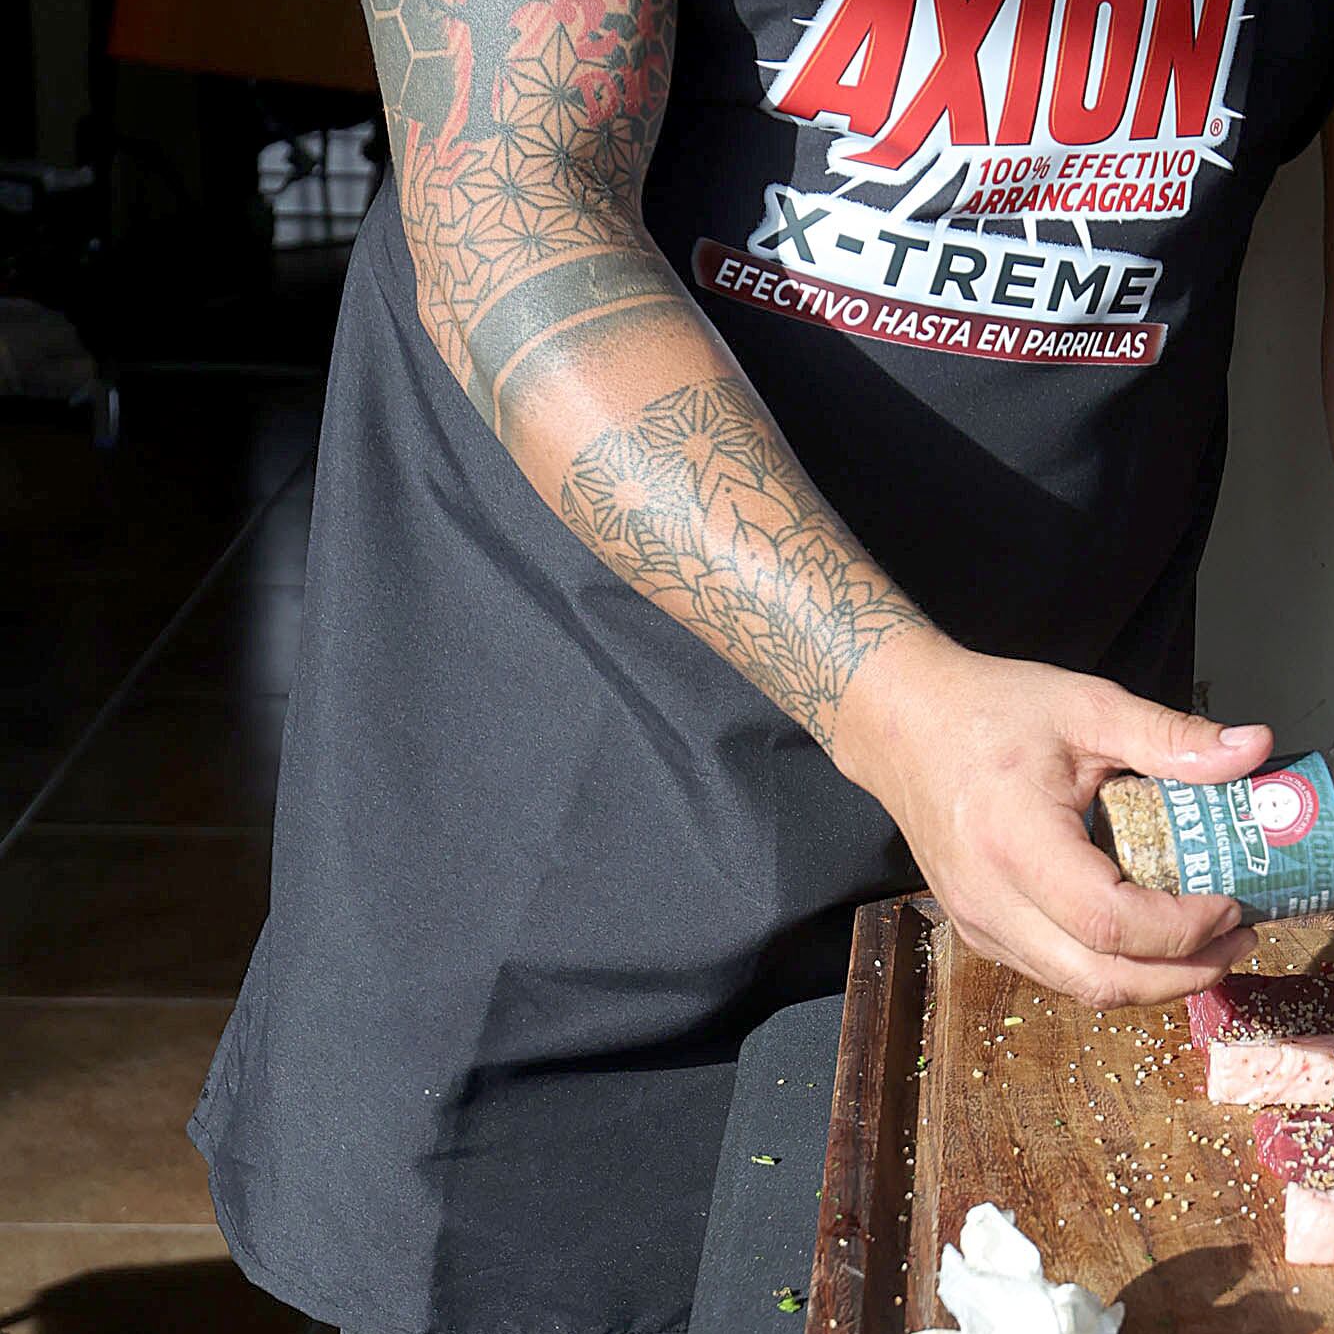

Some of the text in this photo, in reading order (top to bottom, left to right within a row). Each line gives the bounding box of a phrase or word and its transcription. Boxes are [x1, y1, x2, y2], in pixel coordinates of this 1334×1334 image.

[979, 148, 1197, 186] 100% EFECTIVO
[960, 181, 1187, 214] ARRANCAGRASA
[757, 191, 1158, 316] X-TREME
[714, 258, 1150, 360] EFECTIVO HASTA EN PARRILLAS
[1167, 786, 1208, 845] DRY
[1183, 849, 1214, 896] RU
